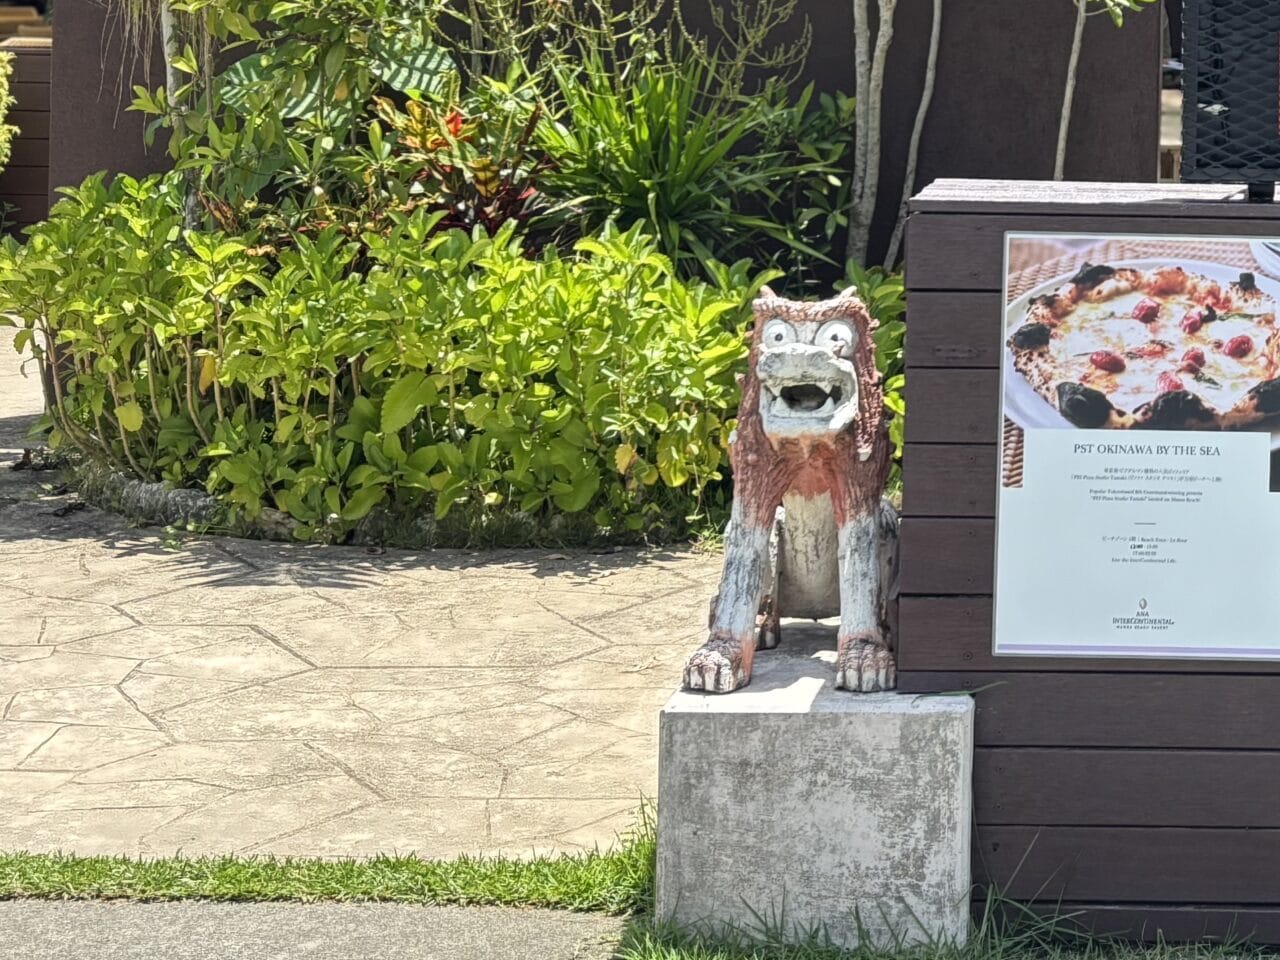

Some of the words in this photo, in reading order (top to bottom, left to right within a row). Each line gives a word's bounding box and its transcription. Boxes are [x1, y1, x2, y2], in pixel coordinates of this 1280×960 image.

[1074, 443, 1095, 455] PST
[1097, 443, 1153, 455] OKINAWA
[1156, 444, 1170, 456] BY
[1171, 445, 1197, 456] THE
[1199, 445, 1222, 457] SEA
